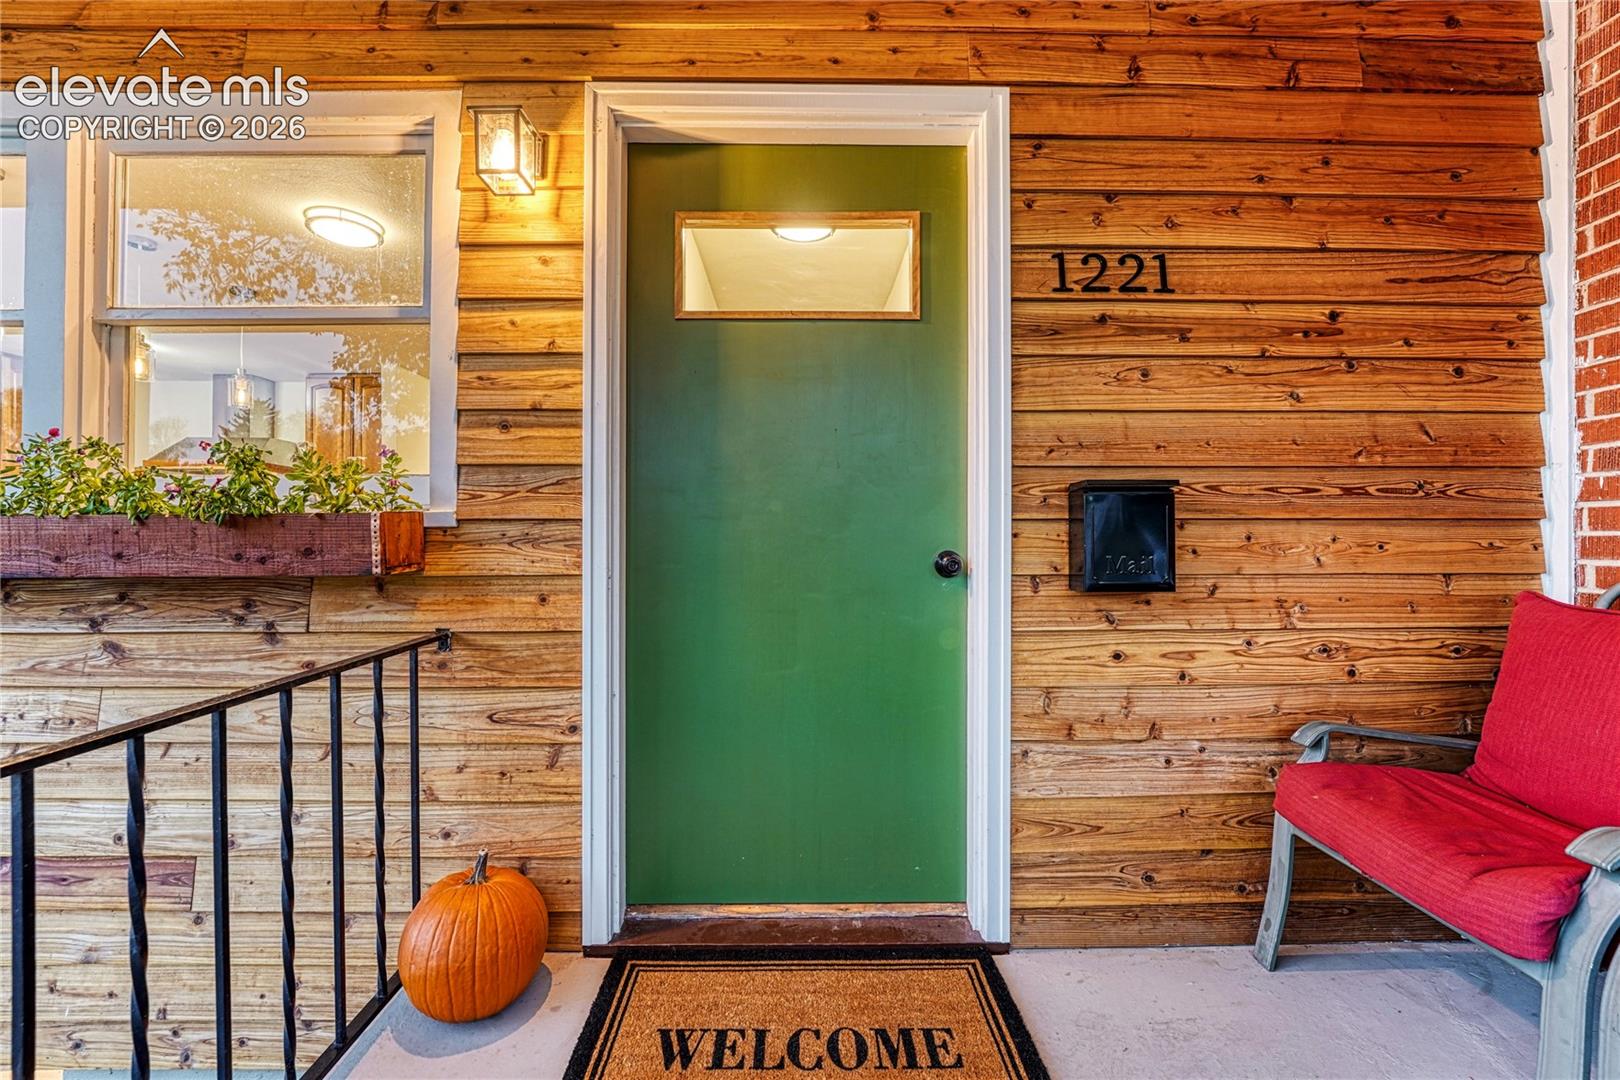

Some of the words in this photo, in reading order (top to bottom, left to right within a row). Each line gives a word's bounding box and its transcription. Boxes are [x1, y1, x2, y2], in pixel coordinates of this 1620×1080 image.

[1051, 252, 1175, 293] 1221
[1105, 555, 1155, 574] Mail
[657, 1027, 963, 1071] WELCOME
